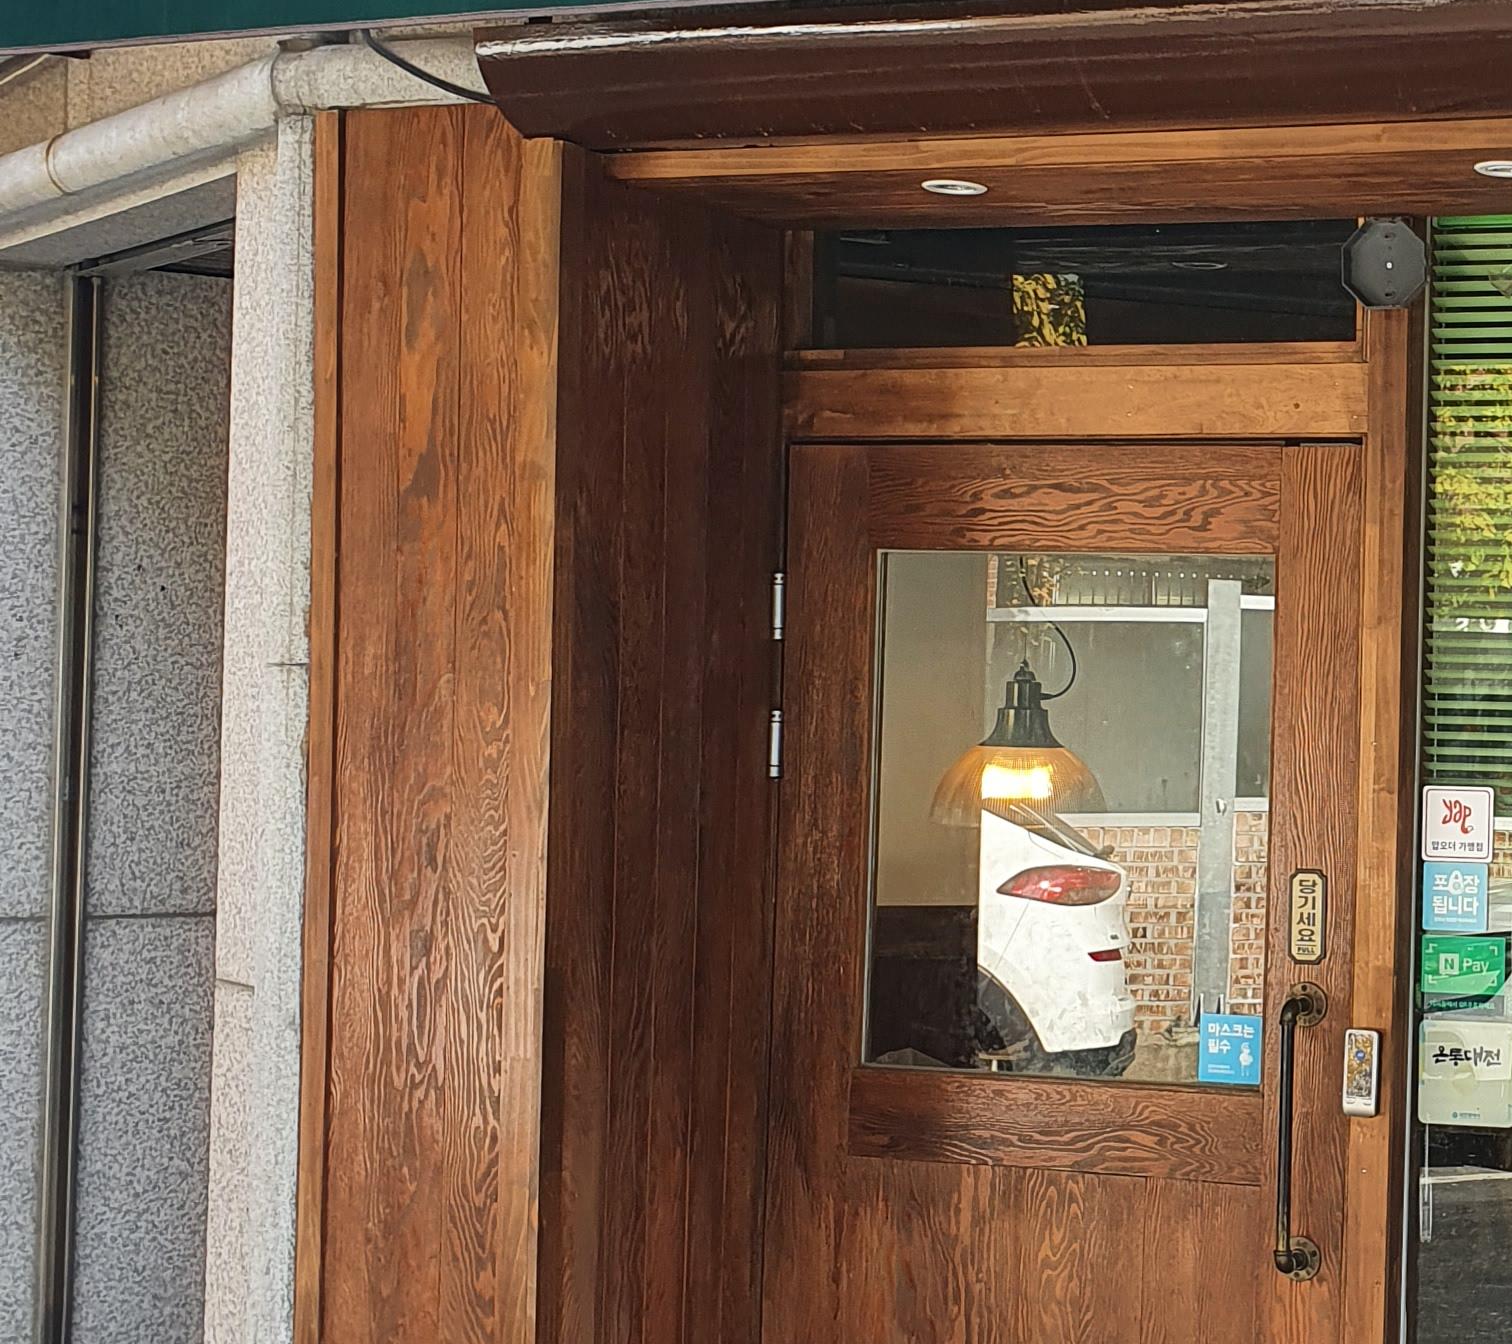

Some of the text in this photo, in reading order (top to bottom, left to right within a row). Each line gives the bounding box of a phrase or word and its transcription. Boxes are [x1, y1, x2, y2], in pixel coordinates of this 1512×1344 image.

[1432, 873, 1480, 894] 포장
[1296, 879, 1318, 942] 당기세요
[1432, 896, 1480, 915] 됩니다
[1463, 958, 1489, 974] Pay
[1207, 1022, 1255, 1039] 마스크는
[1207, 1038, 1231, 1054] 필수
[1432, 1045, 1501, 1067] 온통대전
